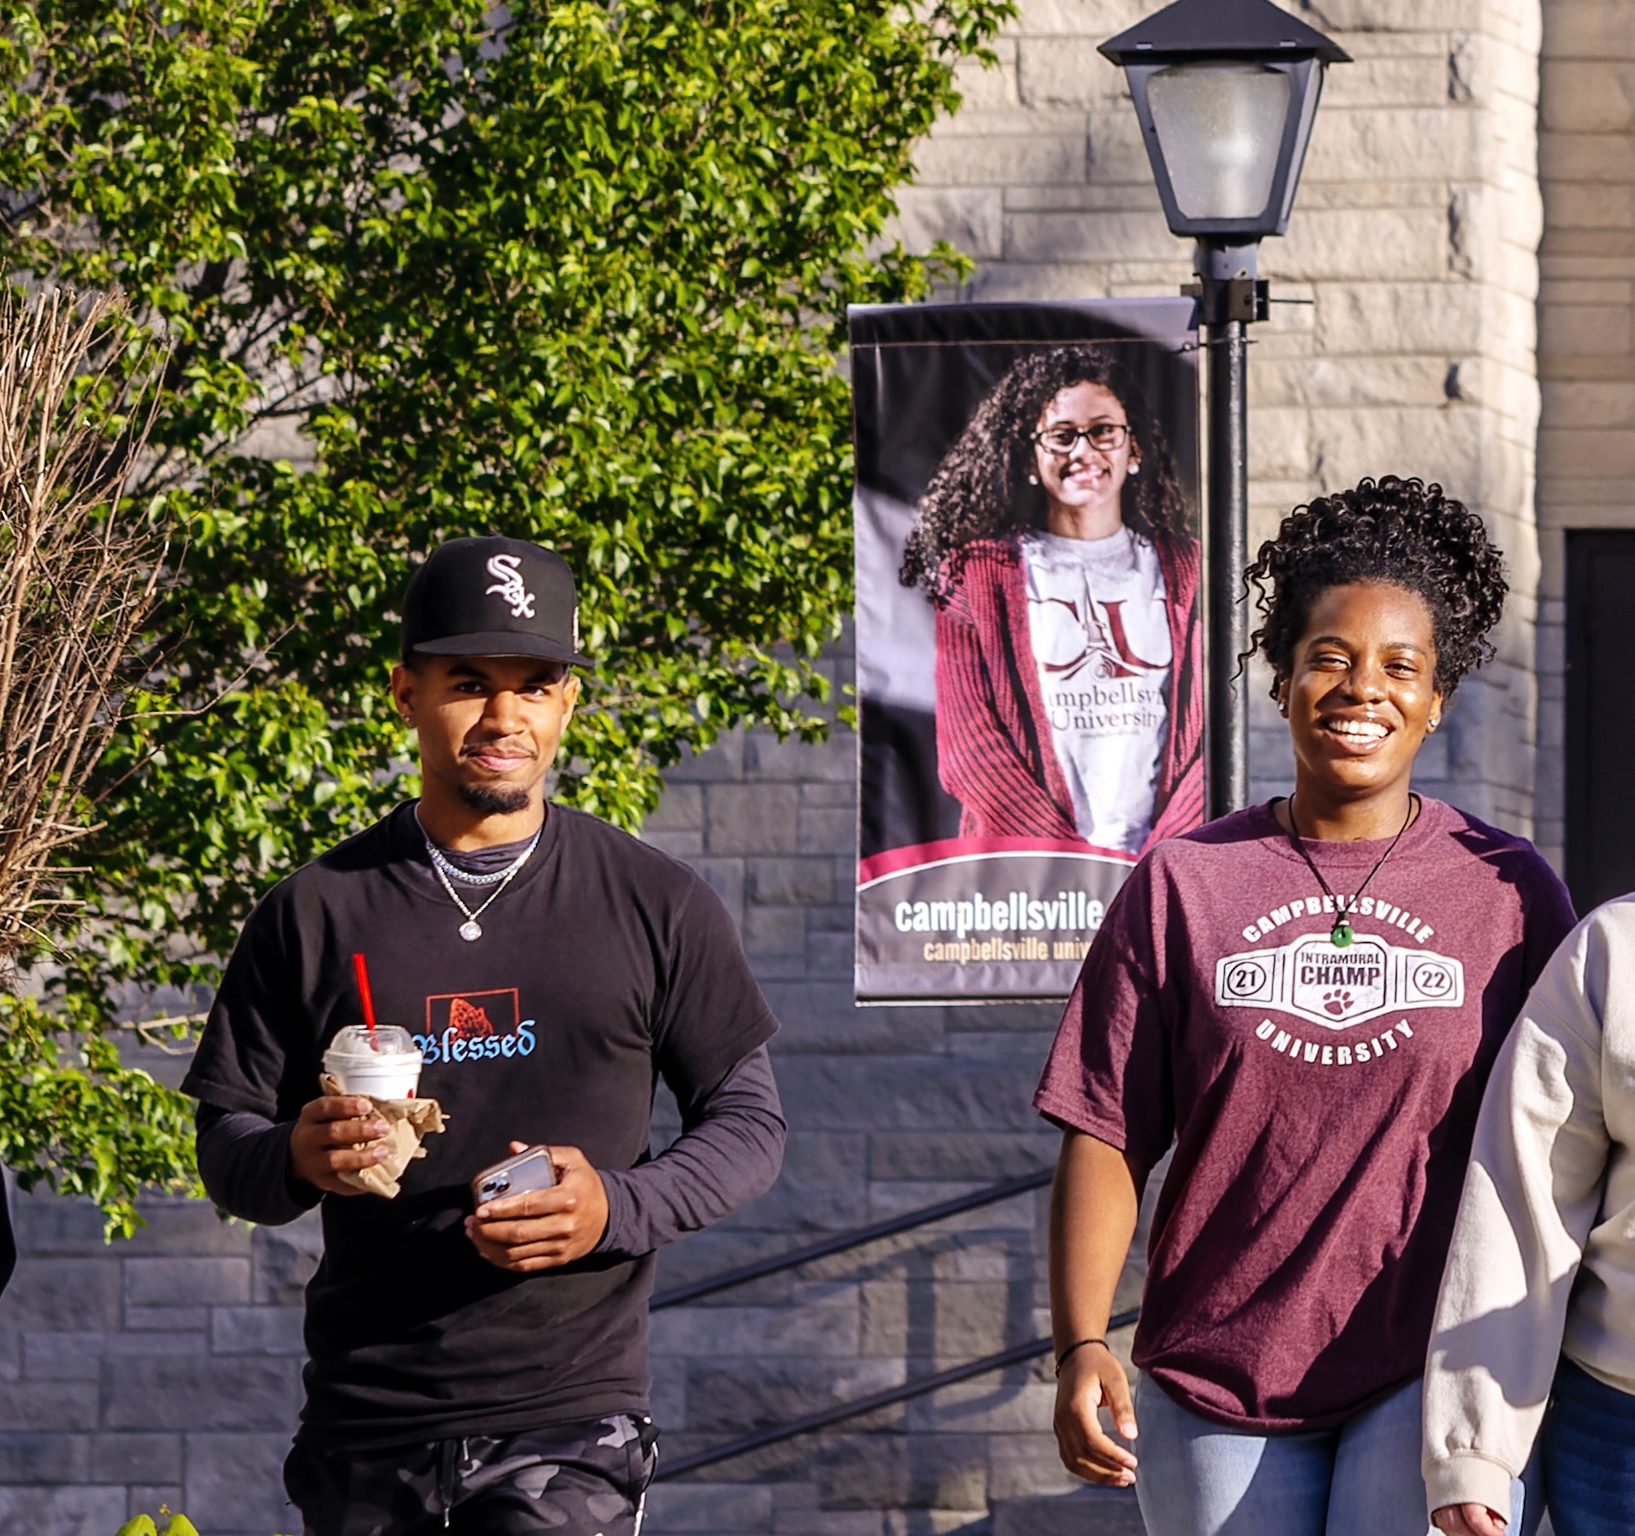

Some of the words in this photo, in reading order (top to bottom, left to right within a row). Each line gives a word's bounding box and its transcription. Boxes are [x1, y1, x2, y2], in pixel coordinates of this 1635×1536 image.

[895, 892, 1105, 939] campbellsville
[1241, 894, 1435, 944] CAMPBELLSVILLE
[923, 938, 1049, 966] campbellsville
[1053, 937, 1093, 961] univ
[1301, 952, 1381, 966] INTRAMURAL
[1236, 970, 1257, 988] 21
[1301, 966, 1381, 987] CHAMP
[1422, 970, 1445, 989] 22
[411, 1020, 537, 1065] Blessed
[1255, 1018, 1414, 1066] UNIVERSITY
